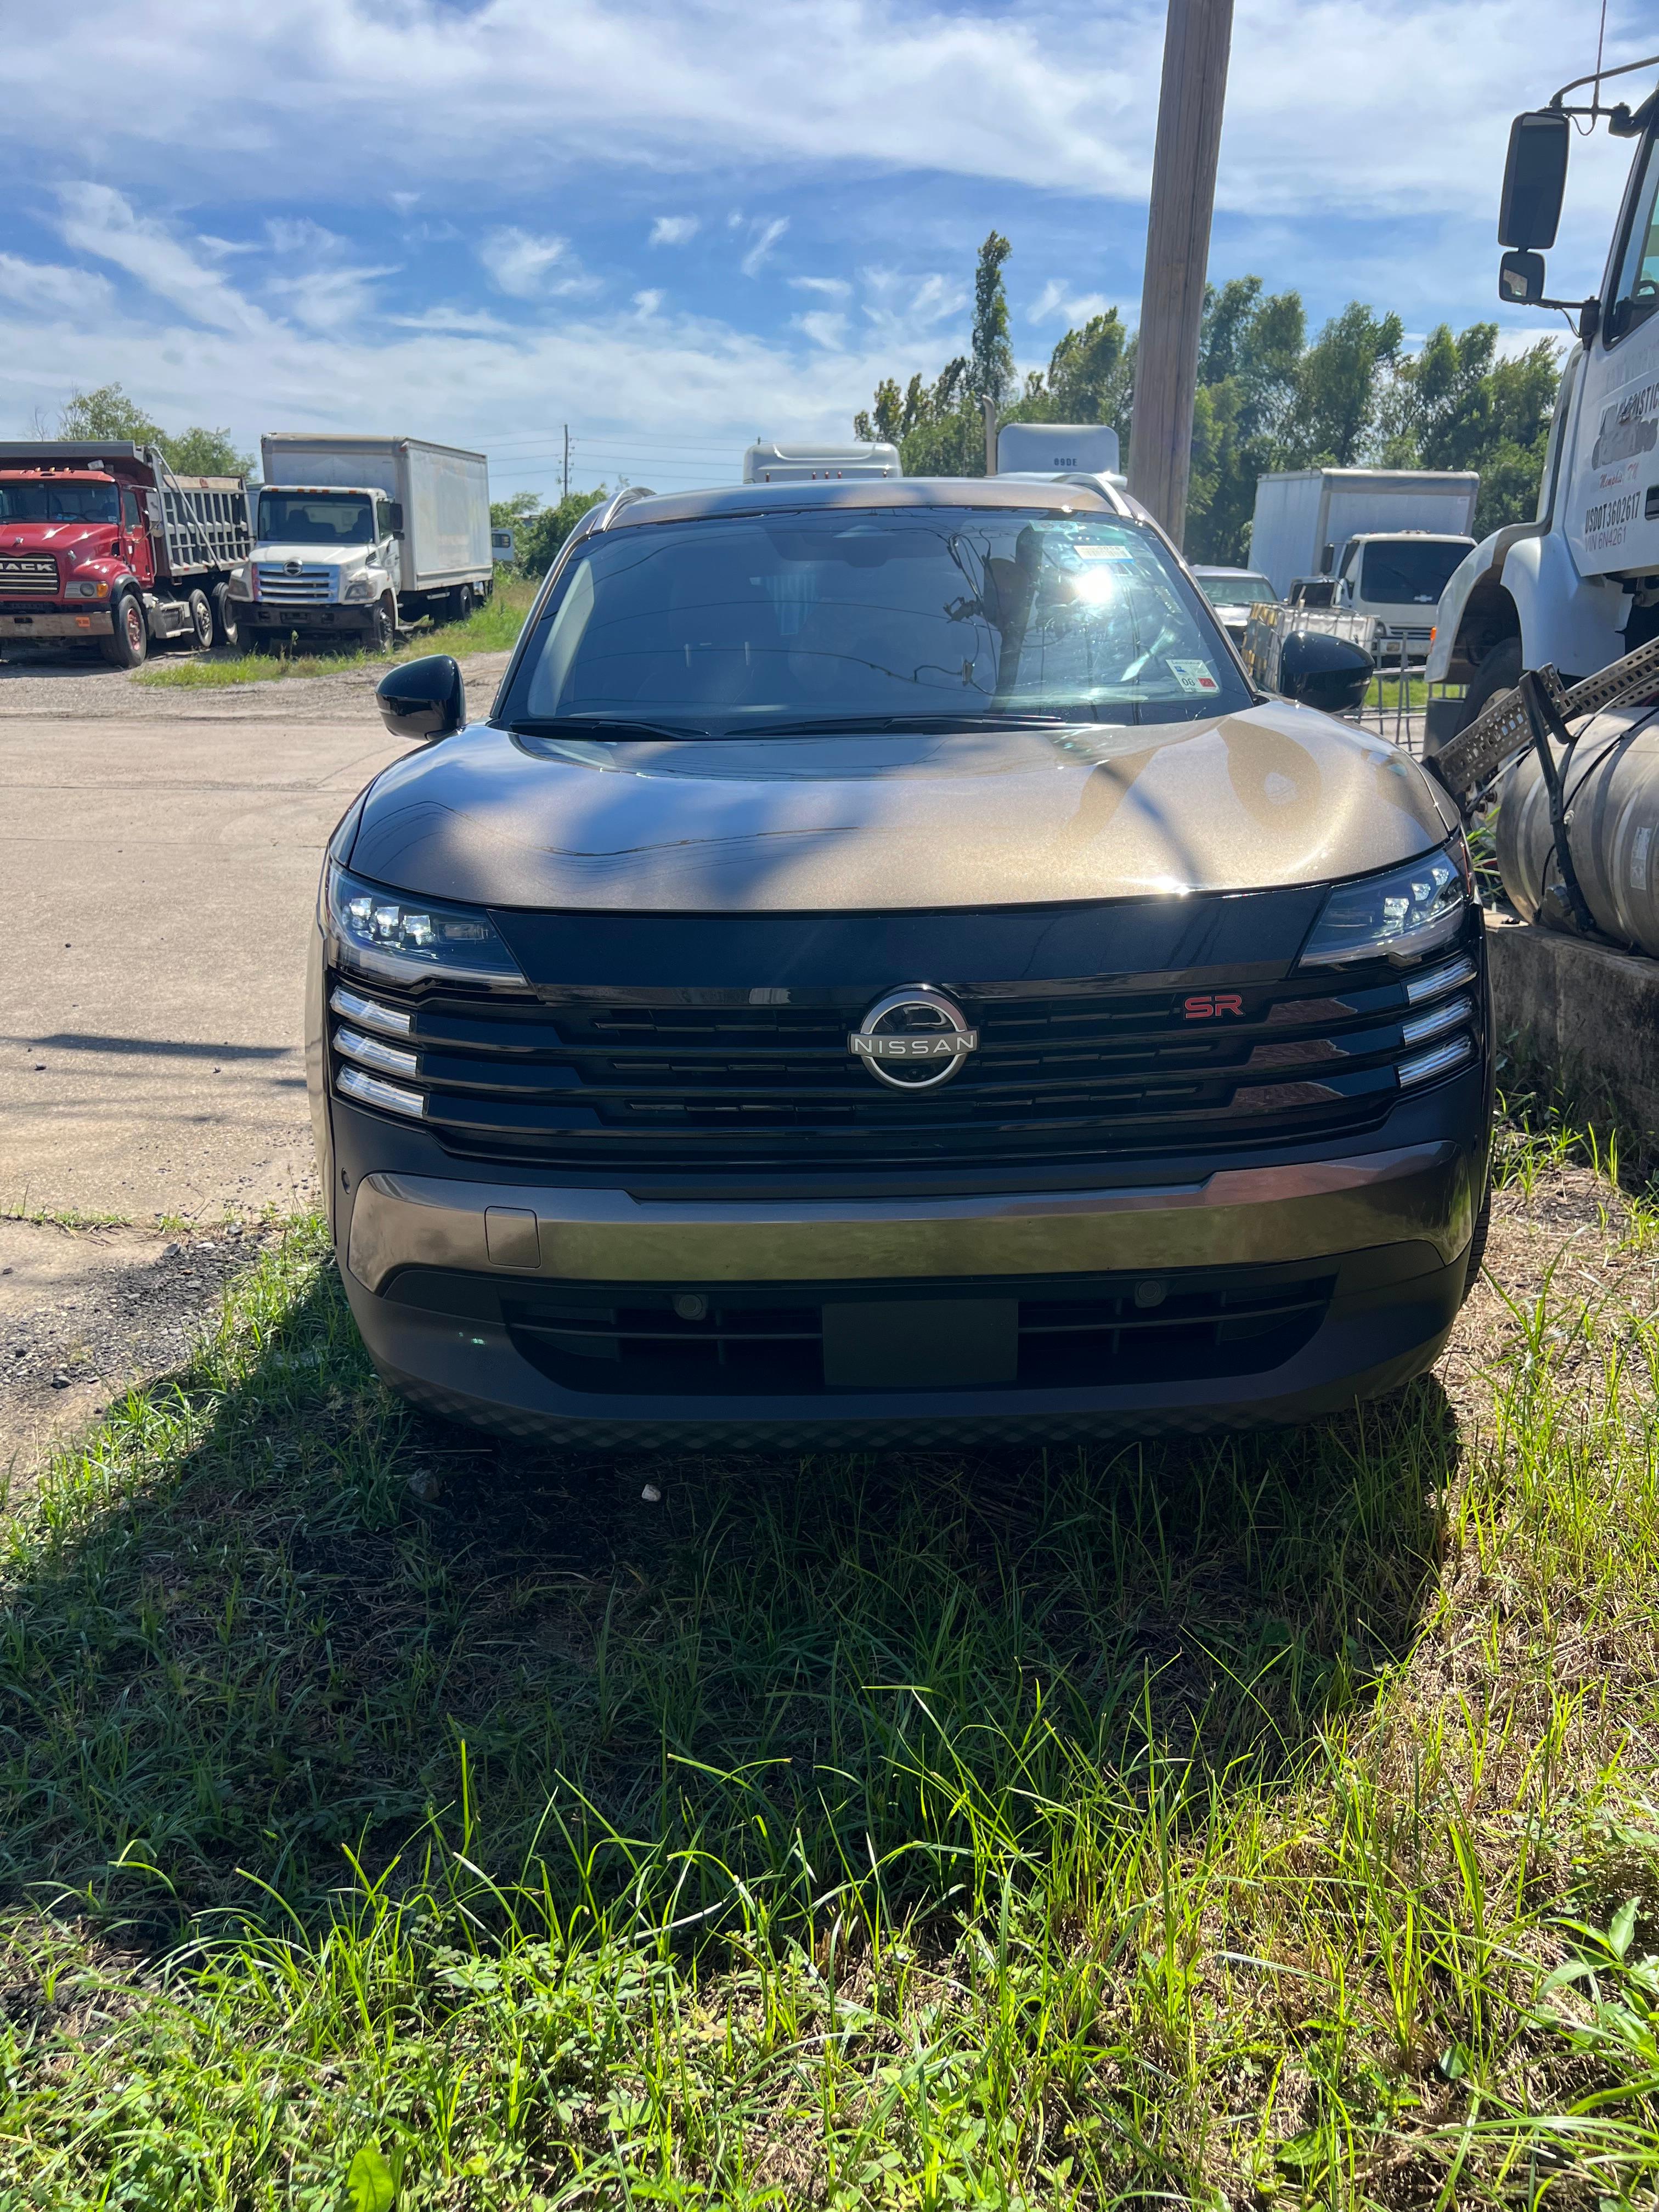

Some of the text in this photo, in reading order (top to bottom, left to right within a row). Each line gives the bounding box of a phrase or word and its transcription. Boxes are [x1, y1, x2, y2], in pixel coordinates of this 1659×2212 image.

[1585, 491, 1641, 534] USDOT3602617
[1585, 526, 1627, 552] VIN 6N4261
[0, 563, 54, 571] ACK
[1184, 995, 1244, 1019] SR
[854, 1035, 974, 1054] NISSAN
